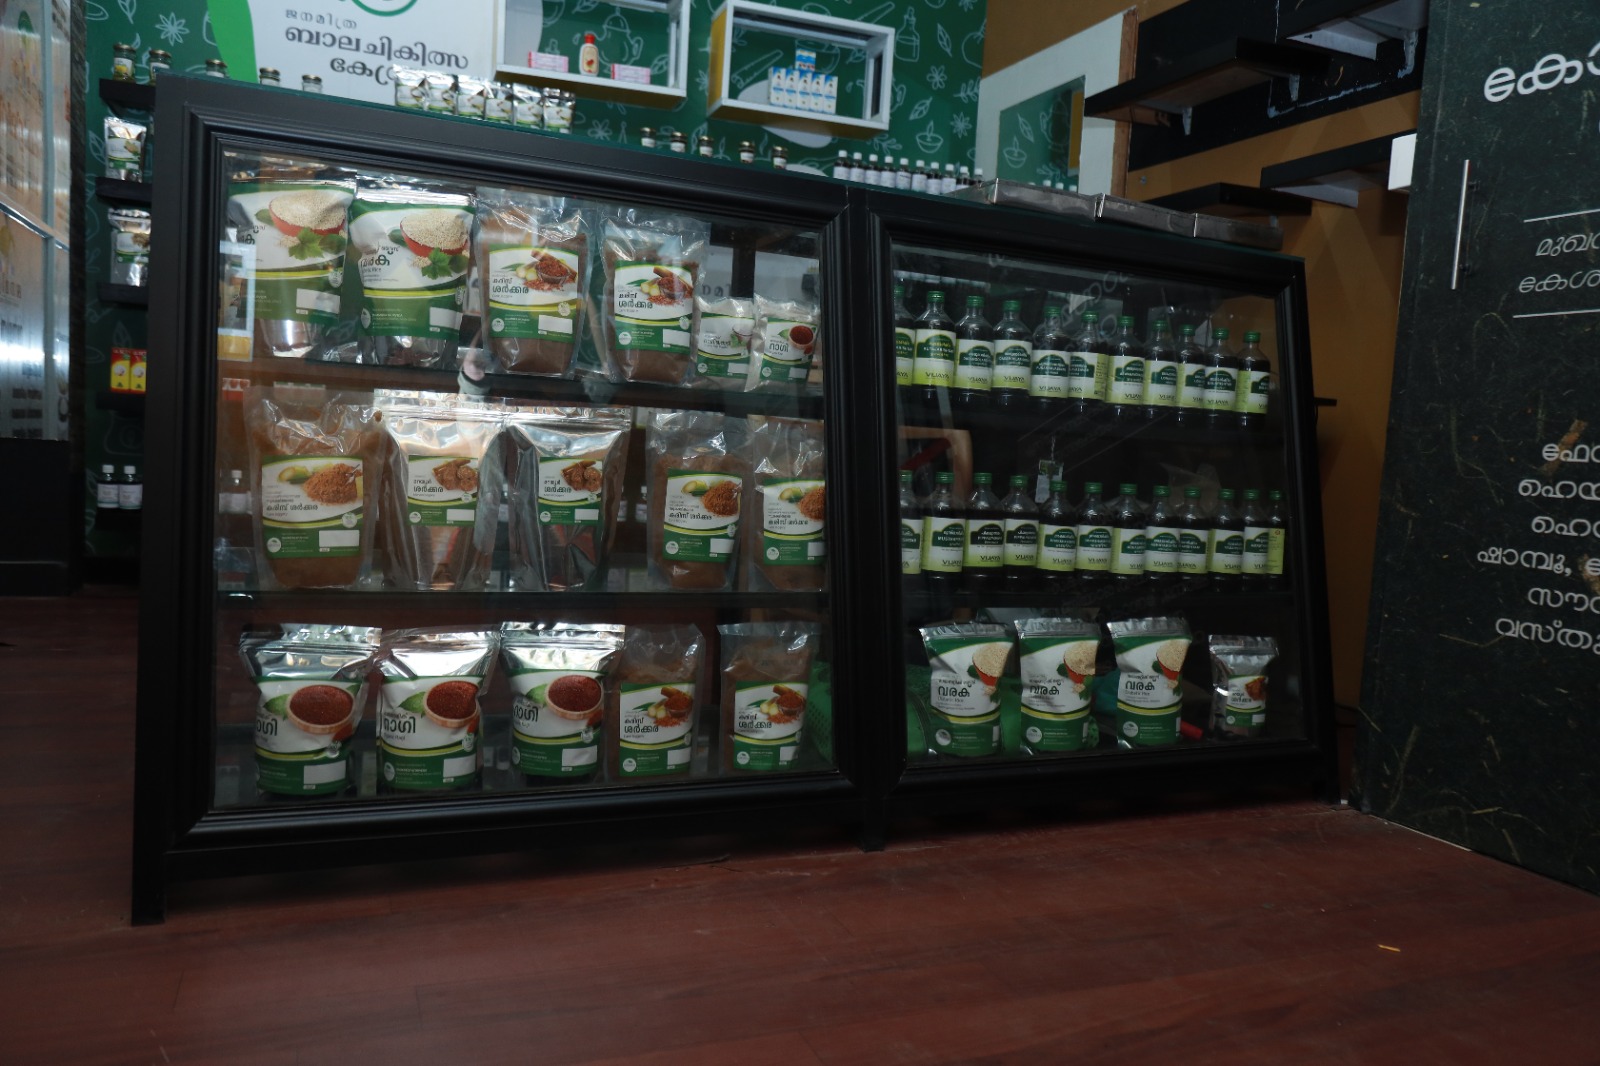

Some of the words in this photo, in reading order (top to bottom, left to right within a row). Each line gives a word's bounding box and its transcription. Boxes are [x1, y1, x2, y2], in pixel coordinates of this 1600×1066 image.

[285, 9, 358, 30] ജനമിത്ര
[285, 26, 469, 70] ബാലചികിത്സ
[925, 371, 950, 379] VIJAYA
[624, 723, 659, 734] ശർക്കര
[738, 720, 772, 729] ശർക്കര
